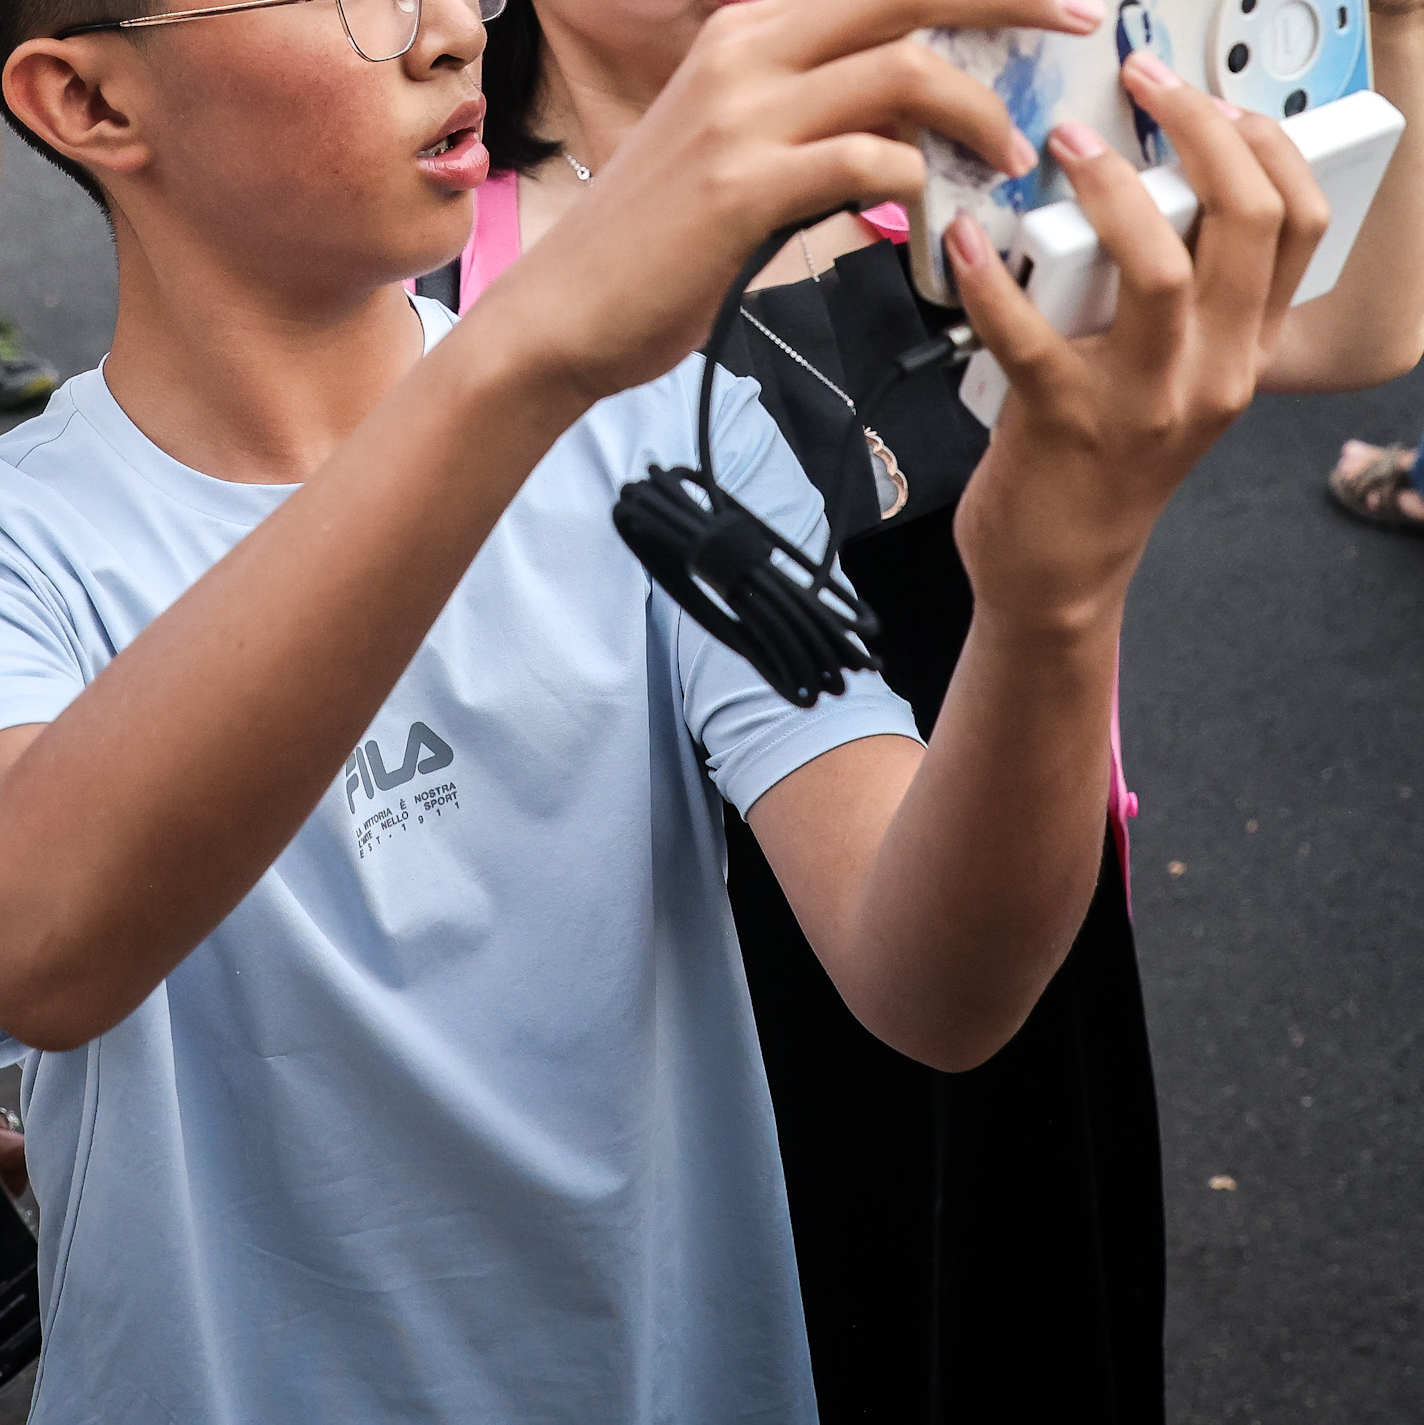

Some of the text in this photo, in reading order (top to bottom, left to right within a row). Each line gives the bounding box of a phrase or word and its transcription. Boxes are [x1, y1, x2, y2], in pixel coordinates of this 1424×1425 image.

[346, 722, 454, 815] FILA
[356, 782, 457, 838] LA VITTORIA È NOSTRA
[381, 811, 409, 831] NELLO
[423, 791, 458, 811] SPORT
